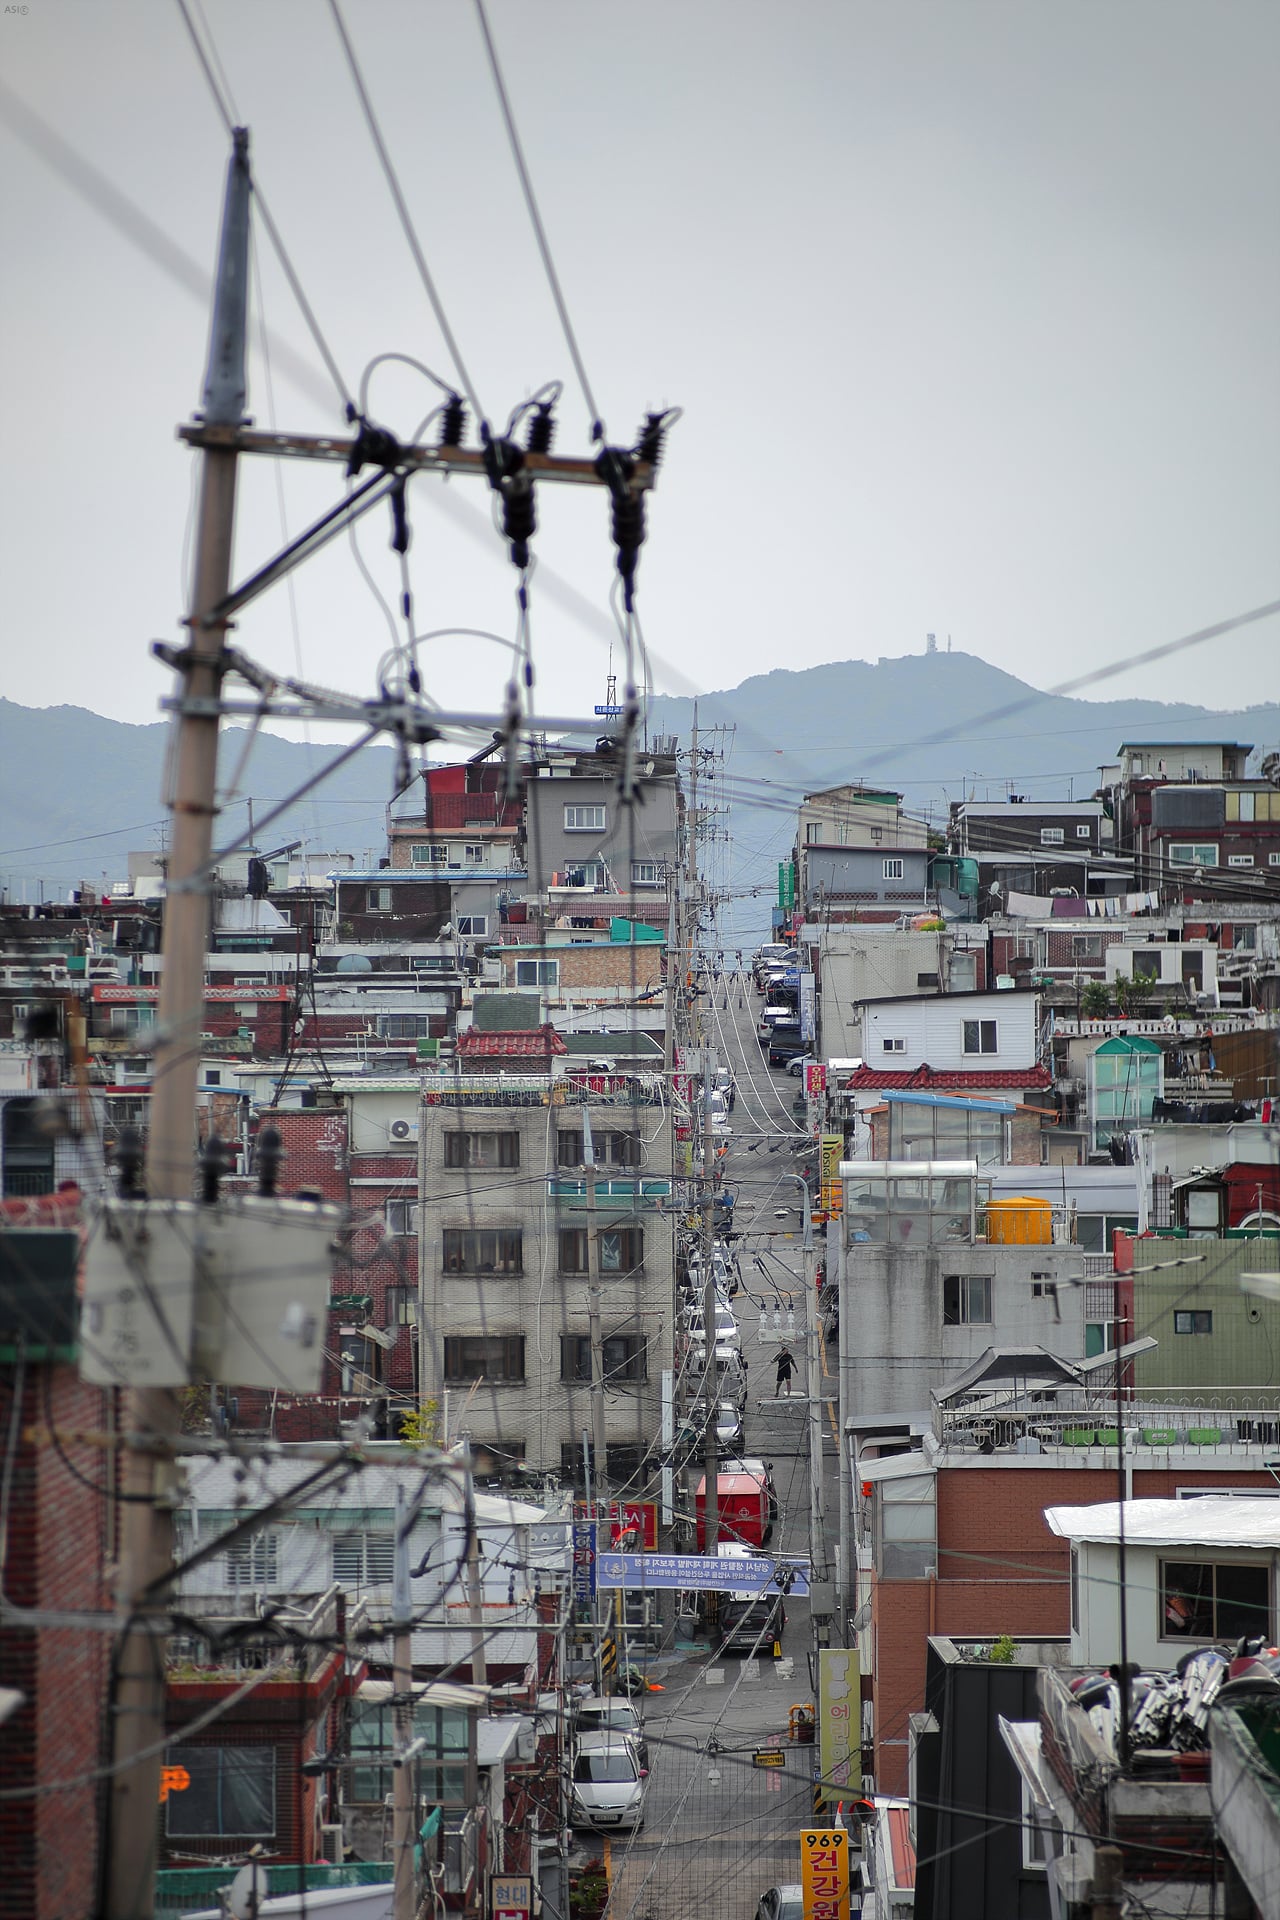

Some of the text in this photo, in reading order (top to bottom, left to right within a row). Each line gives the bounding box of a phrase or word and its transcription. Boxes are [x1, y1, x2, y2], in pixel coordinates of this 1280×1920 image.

[806, 1834, 843, 1848] 969
[496, 1885, 527, 1905] 현대
[809, 1850, 842, 1920] 건강원
